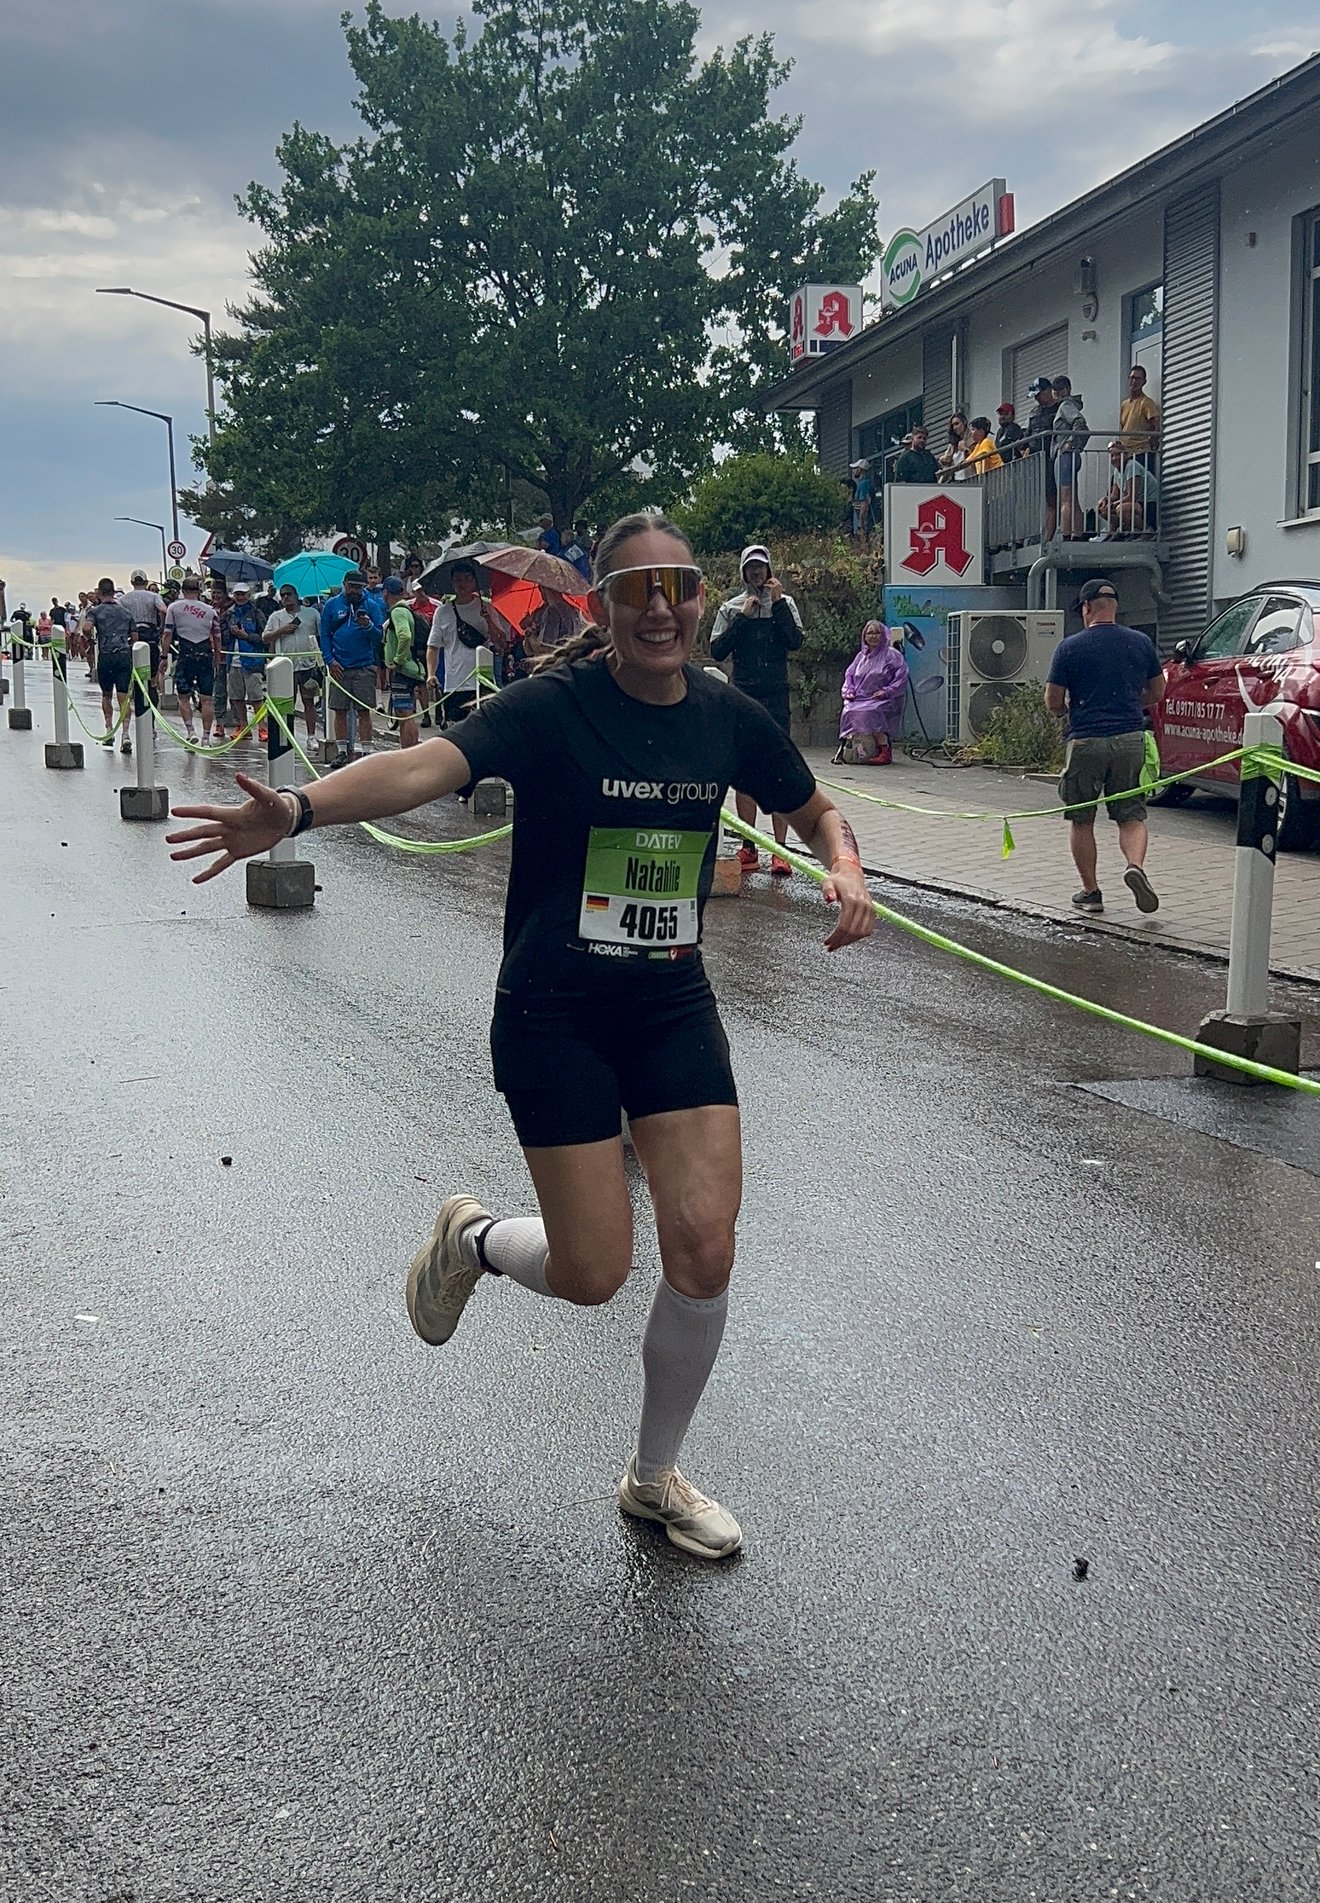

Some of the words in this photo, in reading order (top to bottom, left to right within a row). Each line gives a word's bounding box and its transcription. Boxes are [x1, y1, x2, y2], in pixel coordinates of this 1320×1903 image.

[925, 202, 990, 272] Apotheke
[889, 253, 918, 286] ACUNA
[171, 546, 183, 555] 30
[340, 547, 360, 562] 30
[1165, 698, 1176, 715] Tel.
[1163, 723, 1243, 745] www.acuna-apotheke.d
[602, 778, 664, 799] uvex
[667, 783, 719, 804] group
[635, 832, 683, 849] DATEV
[619, 904, 678, 940] 4055
[588, 942, 622, 957] HOKA
